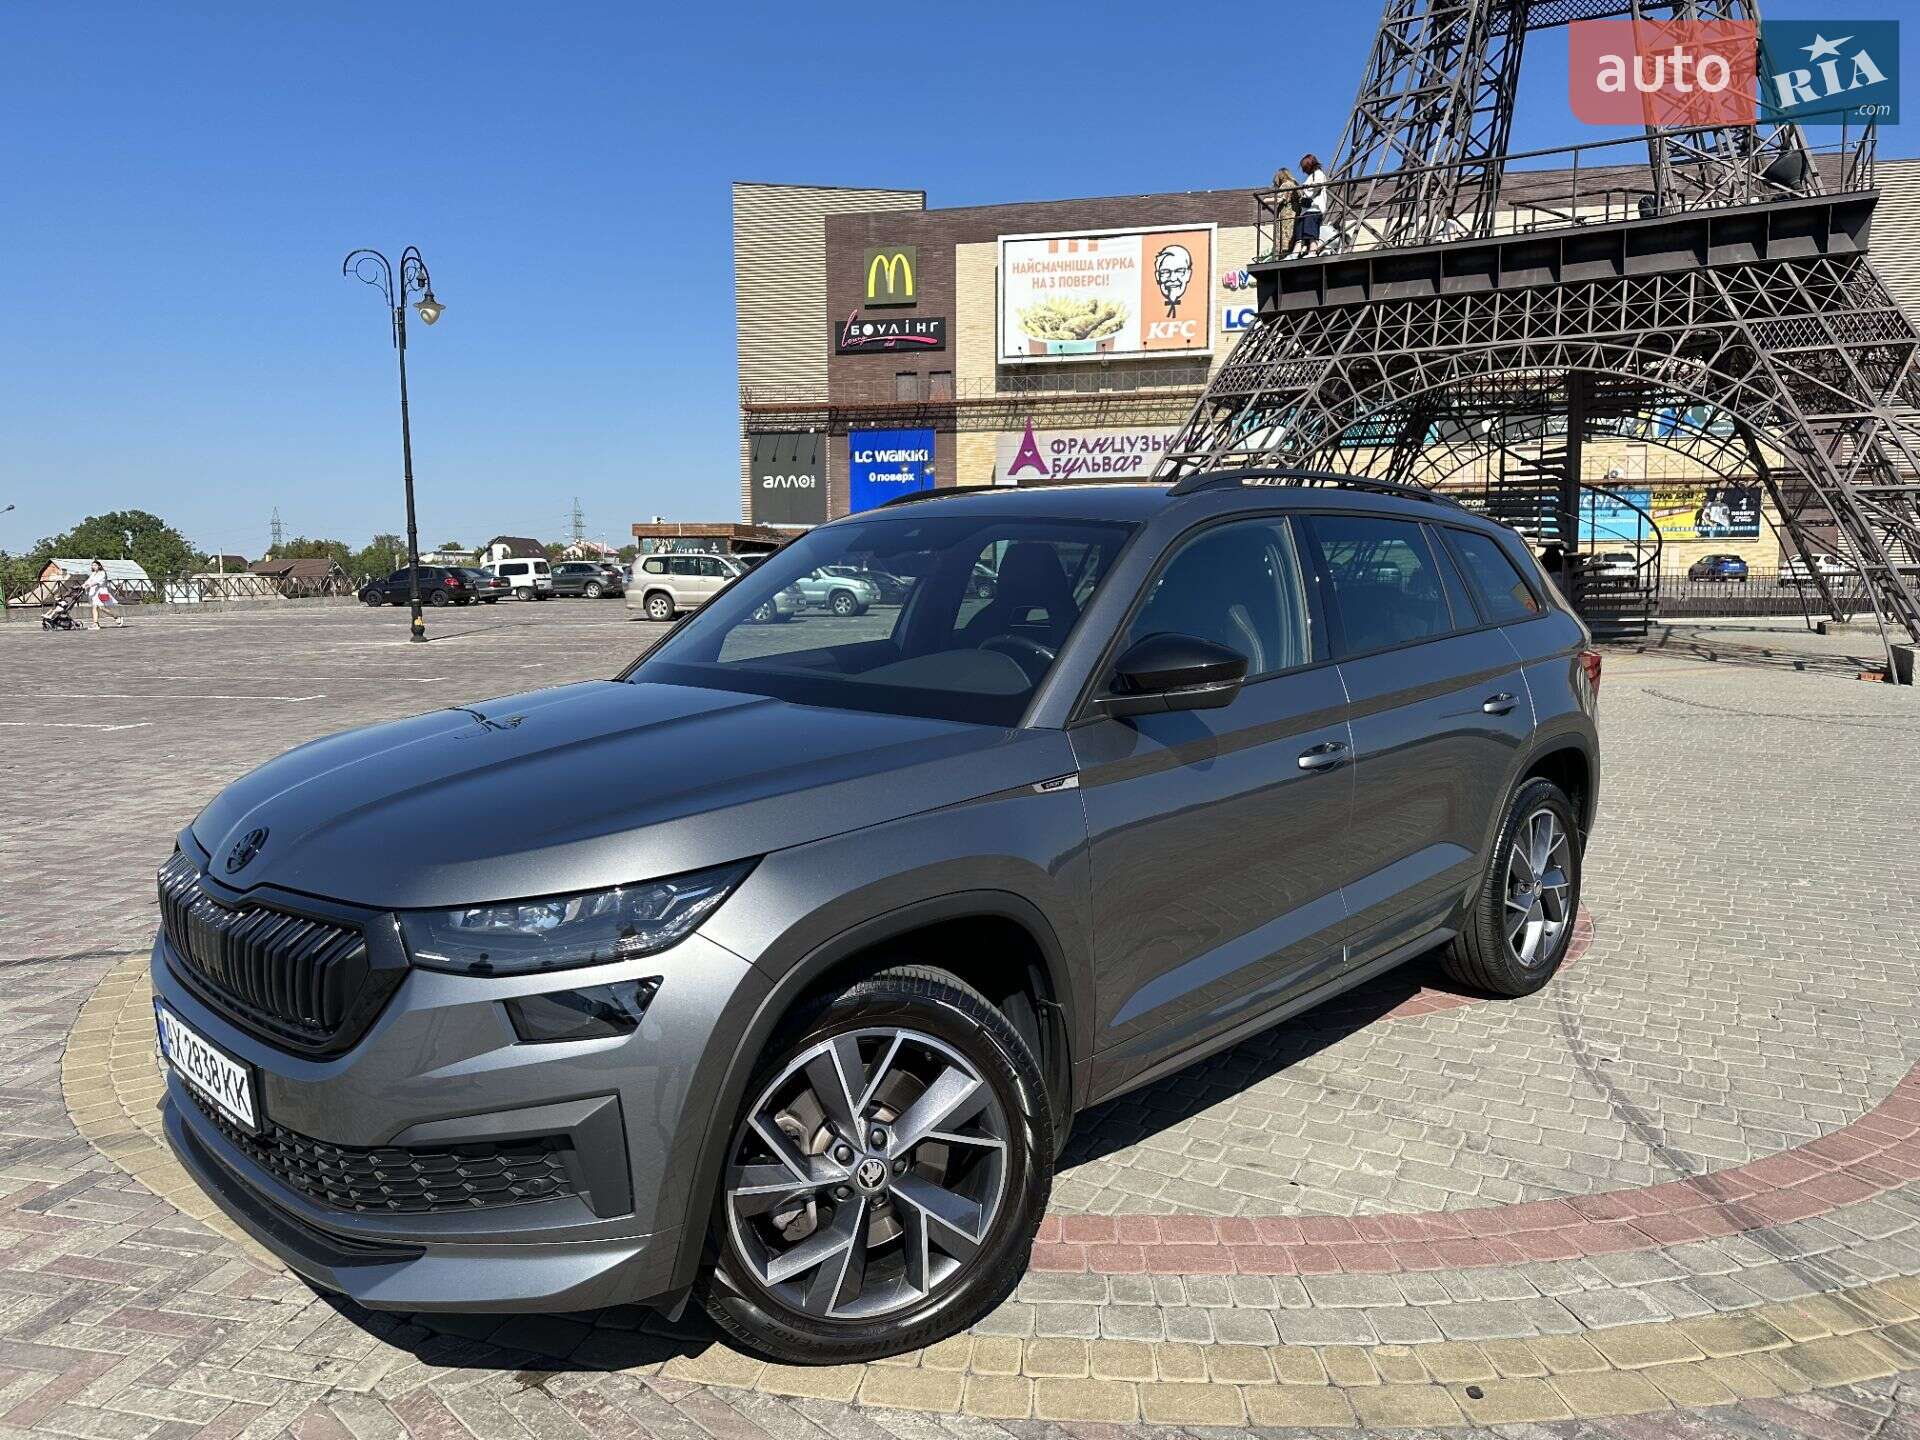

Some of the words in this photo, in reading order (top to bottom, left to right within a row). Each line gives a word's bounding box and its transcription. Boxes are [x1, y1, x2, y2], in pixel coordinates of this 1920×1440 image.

[1012, 258, 1094, 274] НАЙСМАЧНІША
[1096, 256, 1135, 271] КУРКА
[1032, 278, 1048, 289] НА
[1049, 277, 1055, 288] 3
[1058, 275, 1110, 288] ПОВЕРСІ!
[850, 320, 939, 336] БОУЛІНГ
[1148, 320, 1197, 339] KFC
[1051, 434, 1197, 455] ФРАНЦУЗЬК
[854, 450, 873, 463] LC
[869, 472, 876, 482] 0
[877, 473, 915, 484] поверх
[165, 1017, 185, 1065] AX
[185, 1034, 222, 1095] 2838
[220, 1061, 252, 1117] KK
